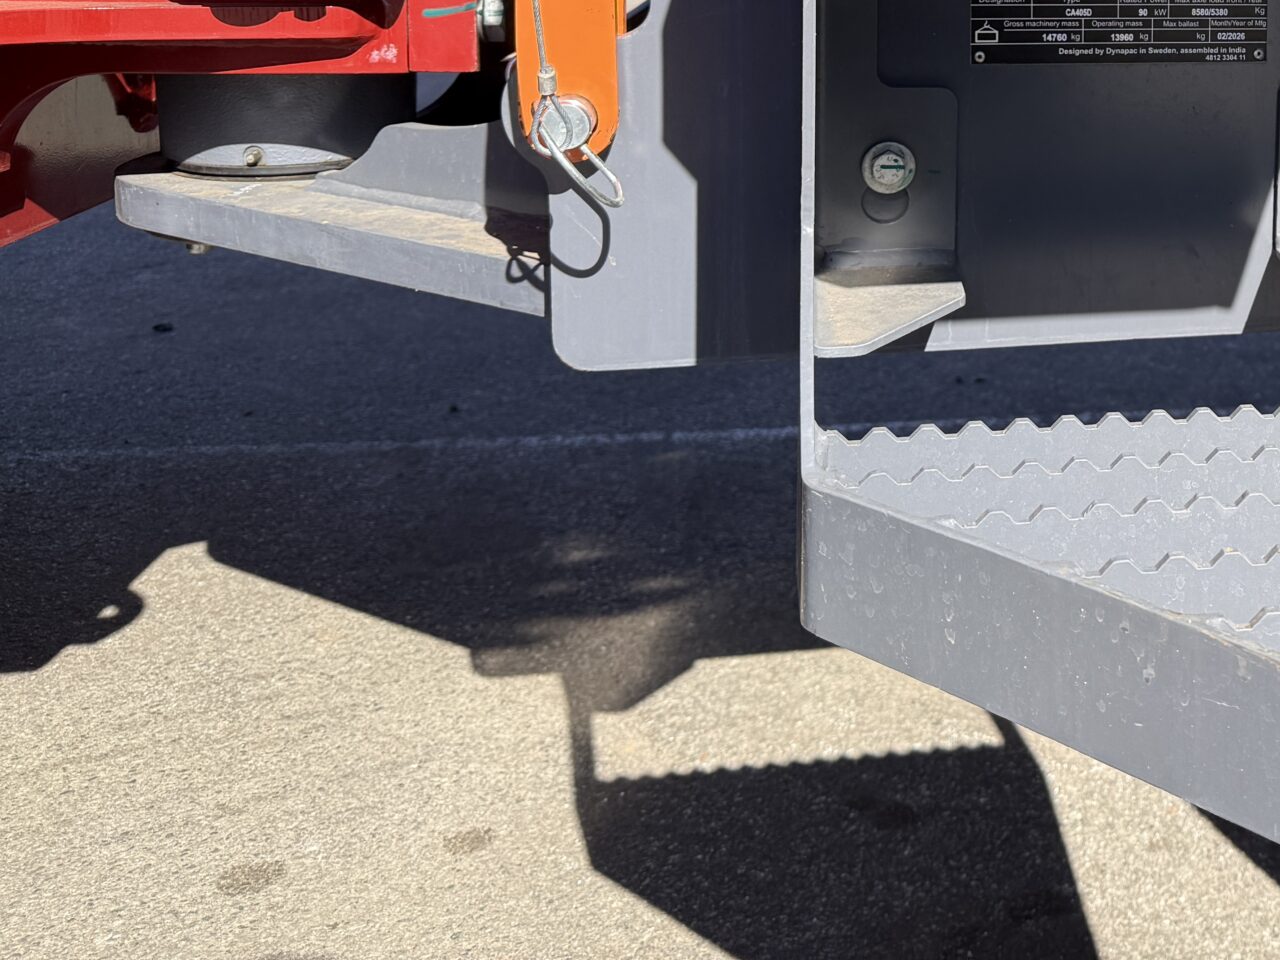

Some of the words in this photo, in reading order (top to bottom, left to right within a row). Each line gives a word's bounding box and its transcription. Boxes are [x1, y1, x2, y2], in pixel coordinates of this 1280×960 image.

[1154, 8, 1167, 16] kW
[1191, 8, 1229, 16] 8580/5380
[1254, 7, 1265, 16] Kg
[1025, 21, 1060, 29] machinery
[1091, 20, 1124, 28] Operating
[1254, 20, 1267, 28] Mfg
[1042, 33, 1068, 42] 14760
[1070, 33, 1081, 41] kg
[1110, 33, 1134, 42] 13960
[1139, 33, 1149, 41] kg
[1196, 33, 1206, 41] kg
[1217, 32, 1246, 40] 02/2026
[1058, 48, 1094, 57] Designed
[1095, 48, 1104, 56] by
[1106, 48, 1138, 56] Dynapac
[1148, 47, 1179, 55] Sweden,
